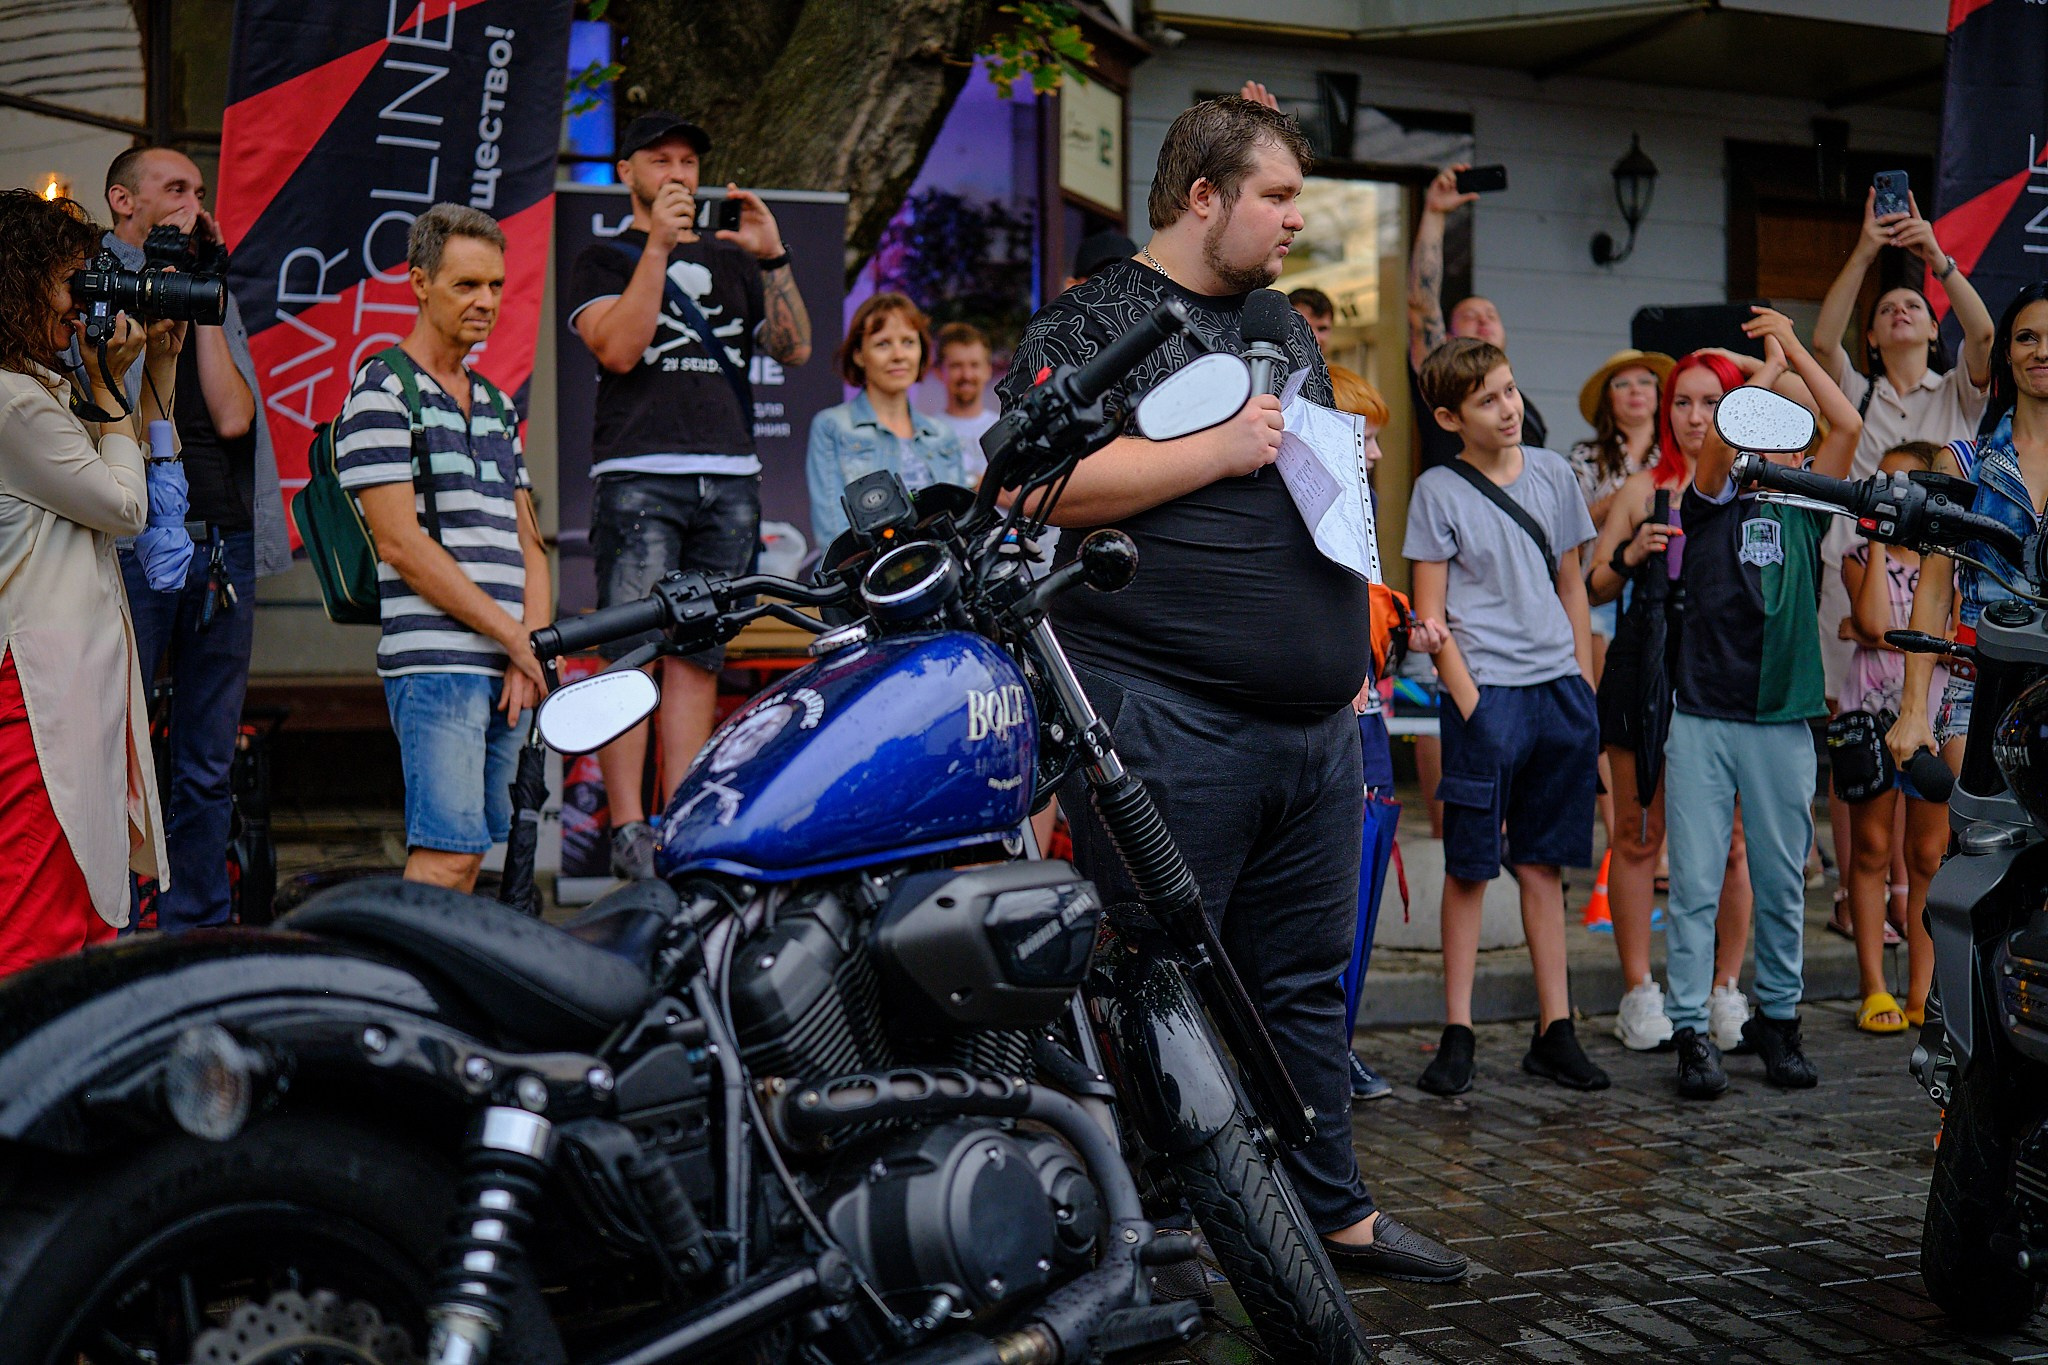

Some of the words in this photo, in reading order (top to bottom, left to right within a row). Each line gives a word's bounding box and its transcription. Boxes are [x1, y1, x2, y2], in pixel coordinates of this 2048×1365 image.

[348, 0, 457, 386] OTOLINE
[468, 25, 515, 210] щество!
[267, 246, 348, 488] AVR
[966, 684, 1025, 741] BOLT
